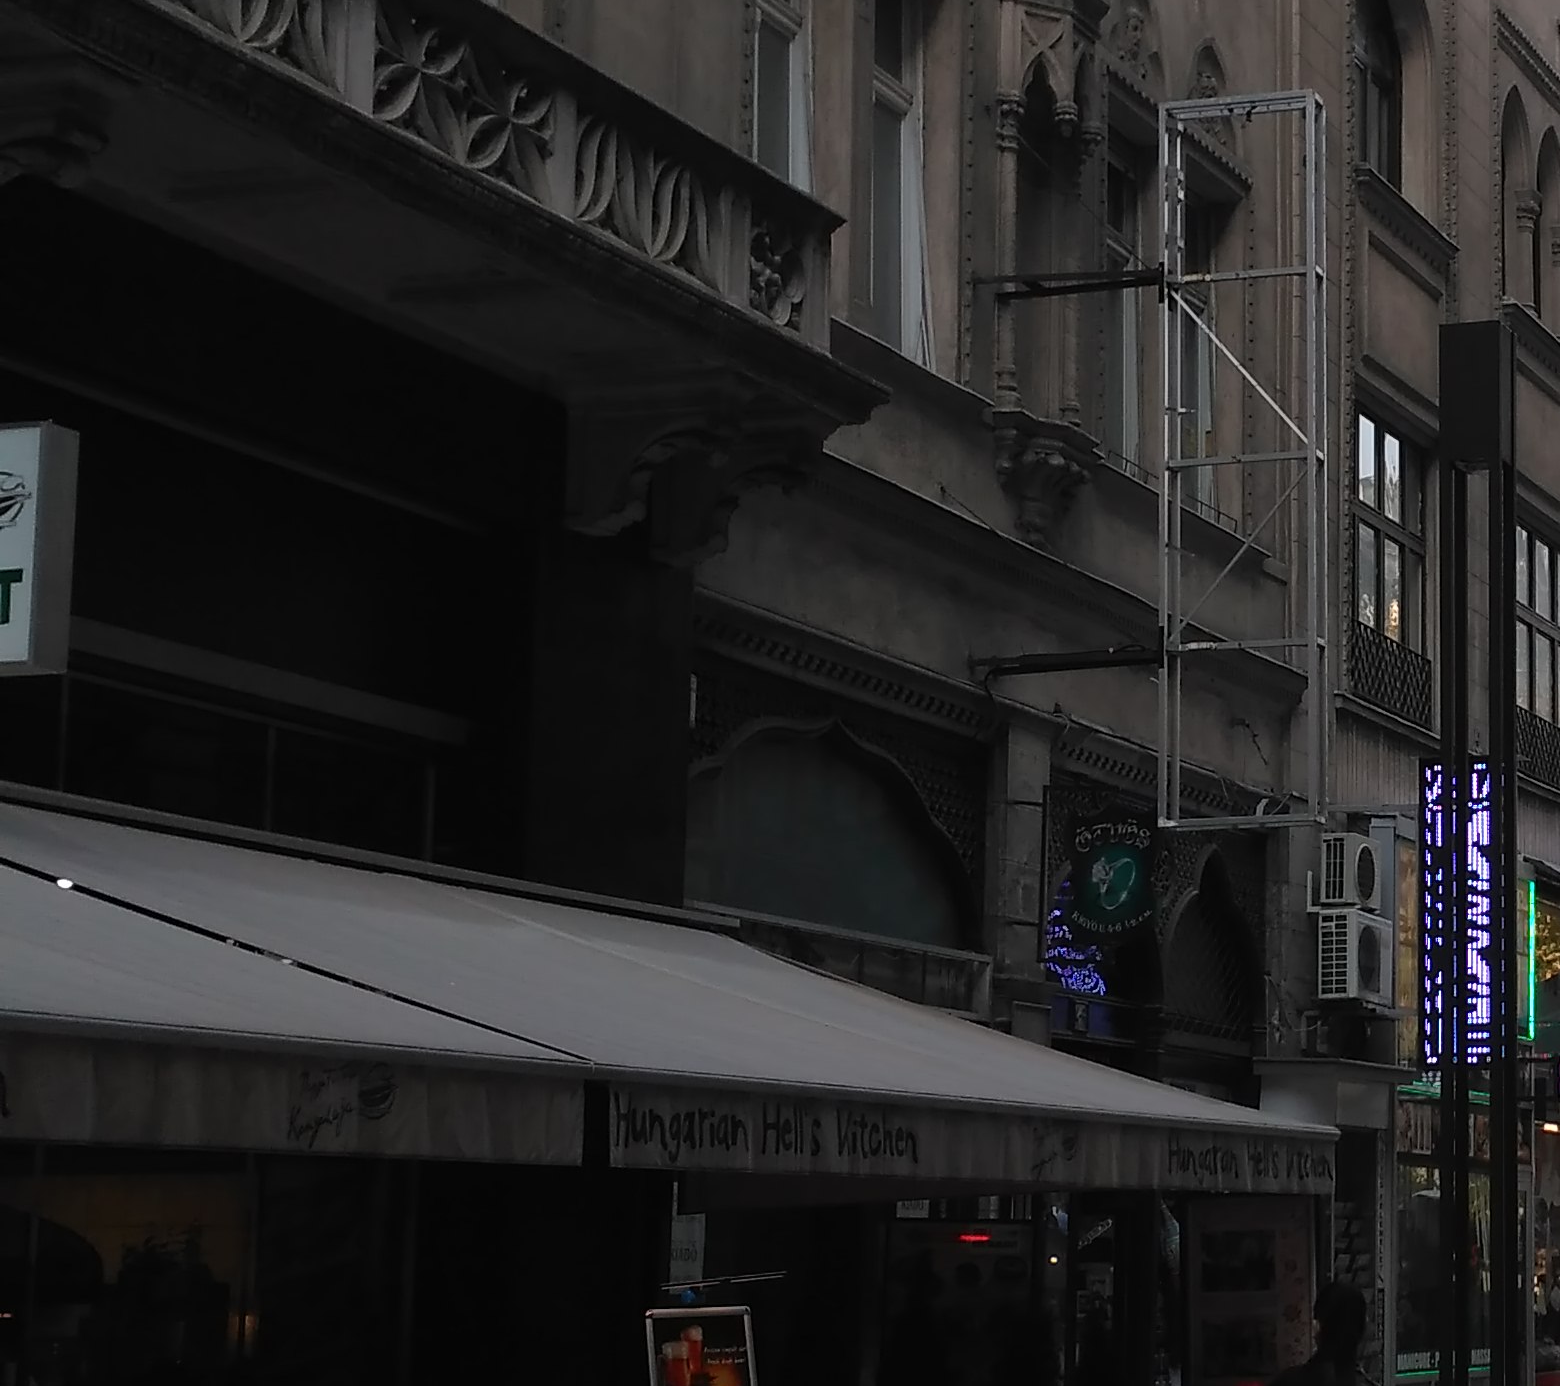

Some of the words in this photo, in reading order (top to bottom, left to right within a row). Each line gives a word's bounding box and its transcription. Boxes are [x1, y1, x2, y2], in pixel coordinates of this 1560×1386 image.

[614, 1090, 749, 1163] Hungarian
[761, 1102, 821, 1156] Hell's
[836, 1109, 918, 1164] Kitchen
